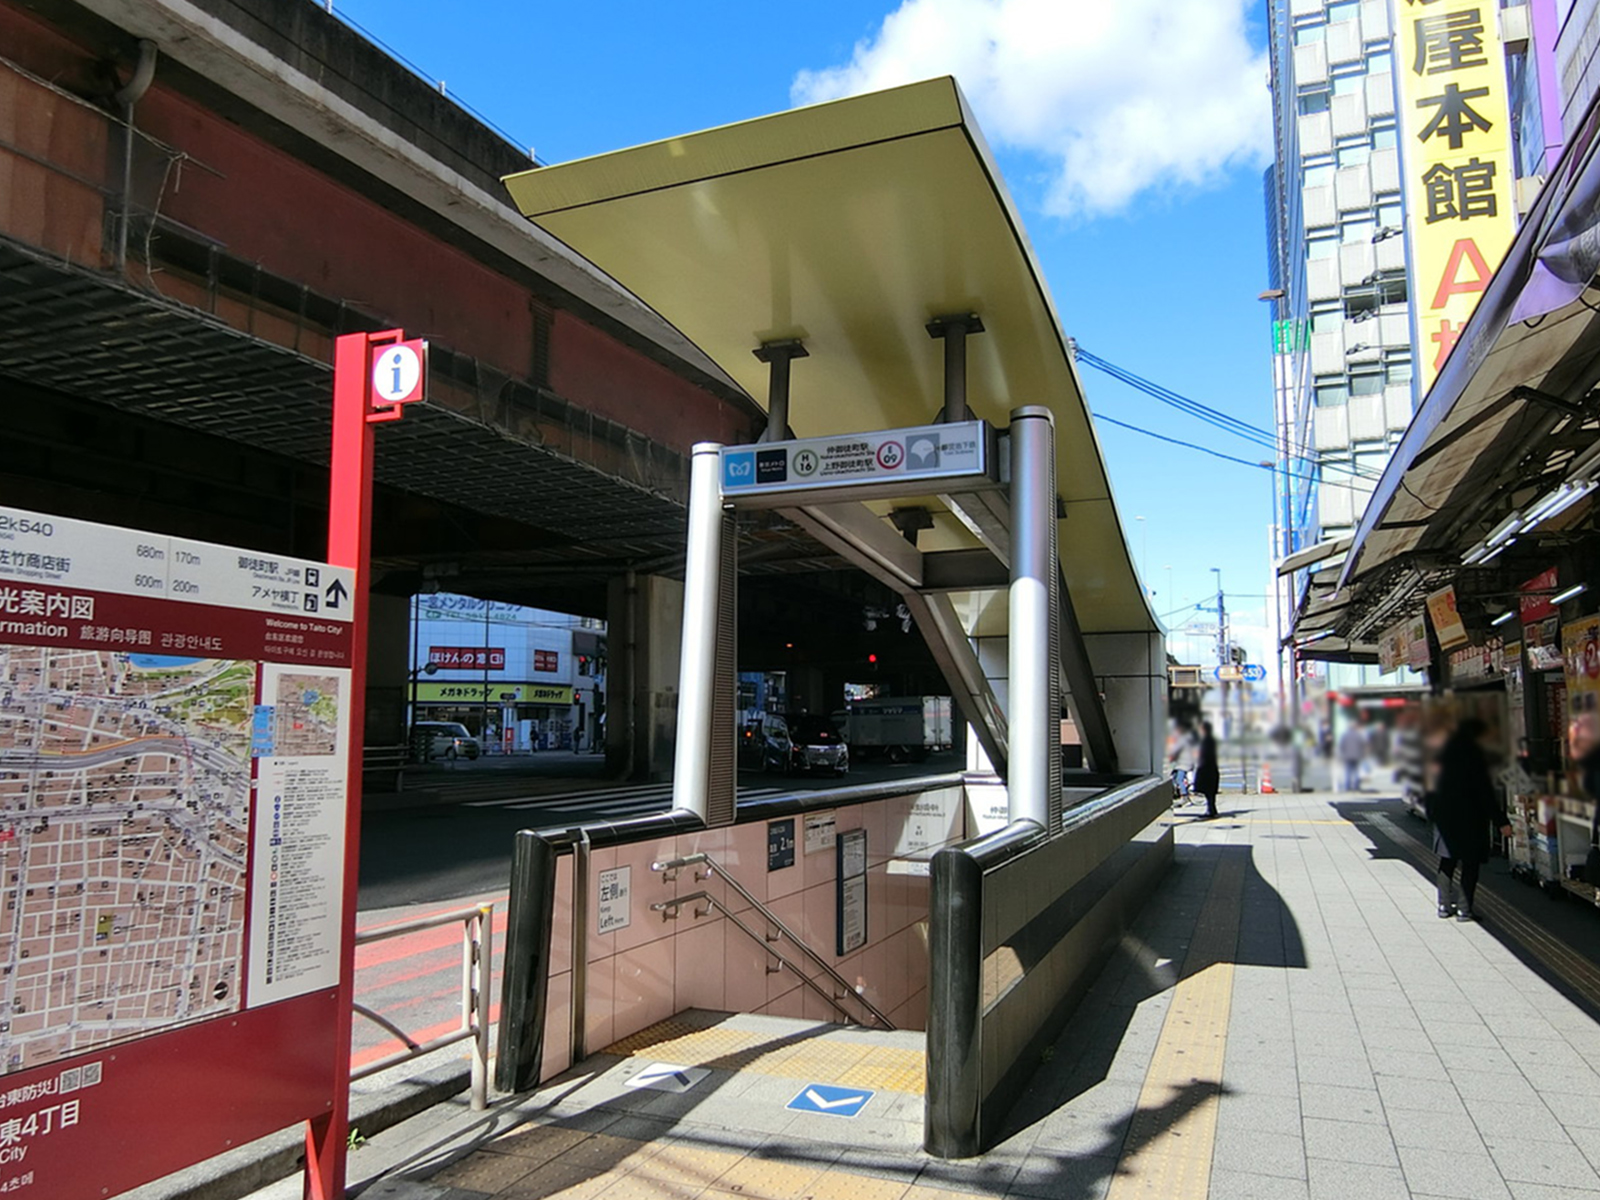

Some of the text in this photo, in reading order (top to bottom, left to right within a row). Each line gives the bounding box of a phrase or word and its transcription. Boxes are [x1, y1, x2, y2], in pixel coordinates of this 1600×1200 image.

[1406, 0, 1497, 373] 屋本館A
[800, 462, 812, 471] 16
[883, 454, 897, 464] 09
[0, 515, 53, 537] 2k540
[136, 544, 164, 560] 680m
[175, 551, 201, 565] 170m
[238, 556, 279, 574] 御徒町駅
[135, 574, 163, 589] 600m
[173, 579, 200, 594] 200m
[0, 587, 94, 620] 光案内図
[252, 586, 300, 604] アメヤ横丁
[265, 618, 299, 630] Welcome
[300, 622, 308, 630] to
[309, 623, 326, 633] Taito
[161, 633, 223, 651] 관광안내도
[440, 686, 494, 698] メガネドラッグ
[0, 1099, 80, 1148] 東4丁目
[0, 1145, 28, 1164] City
